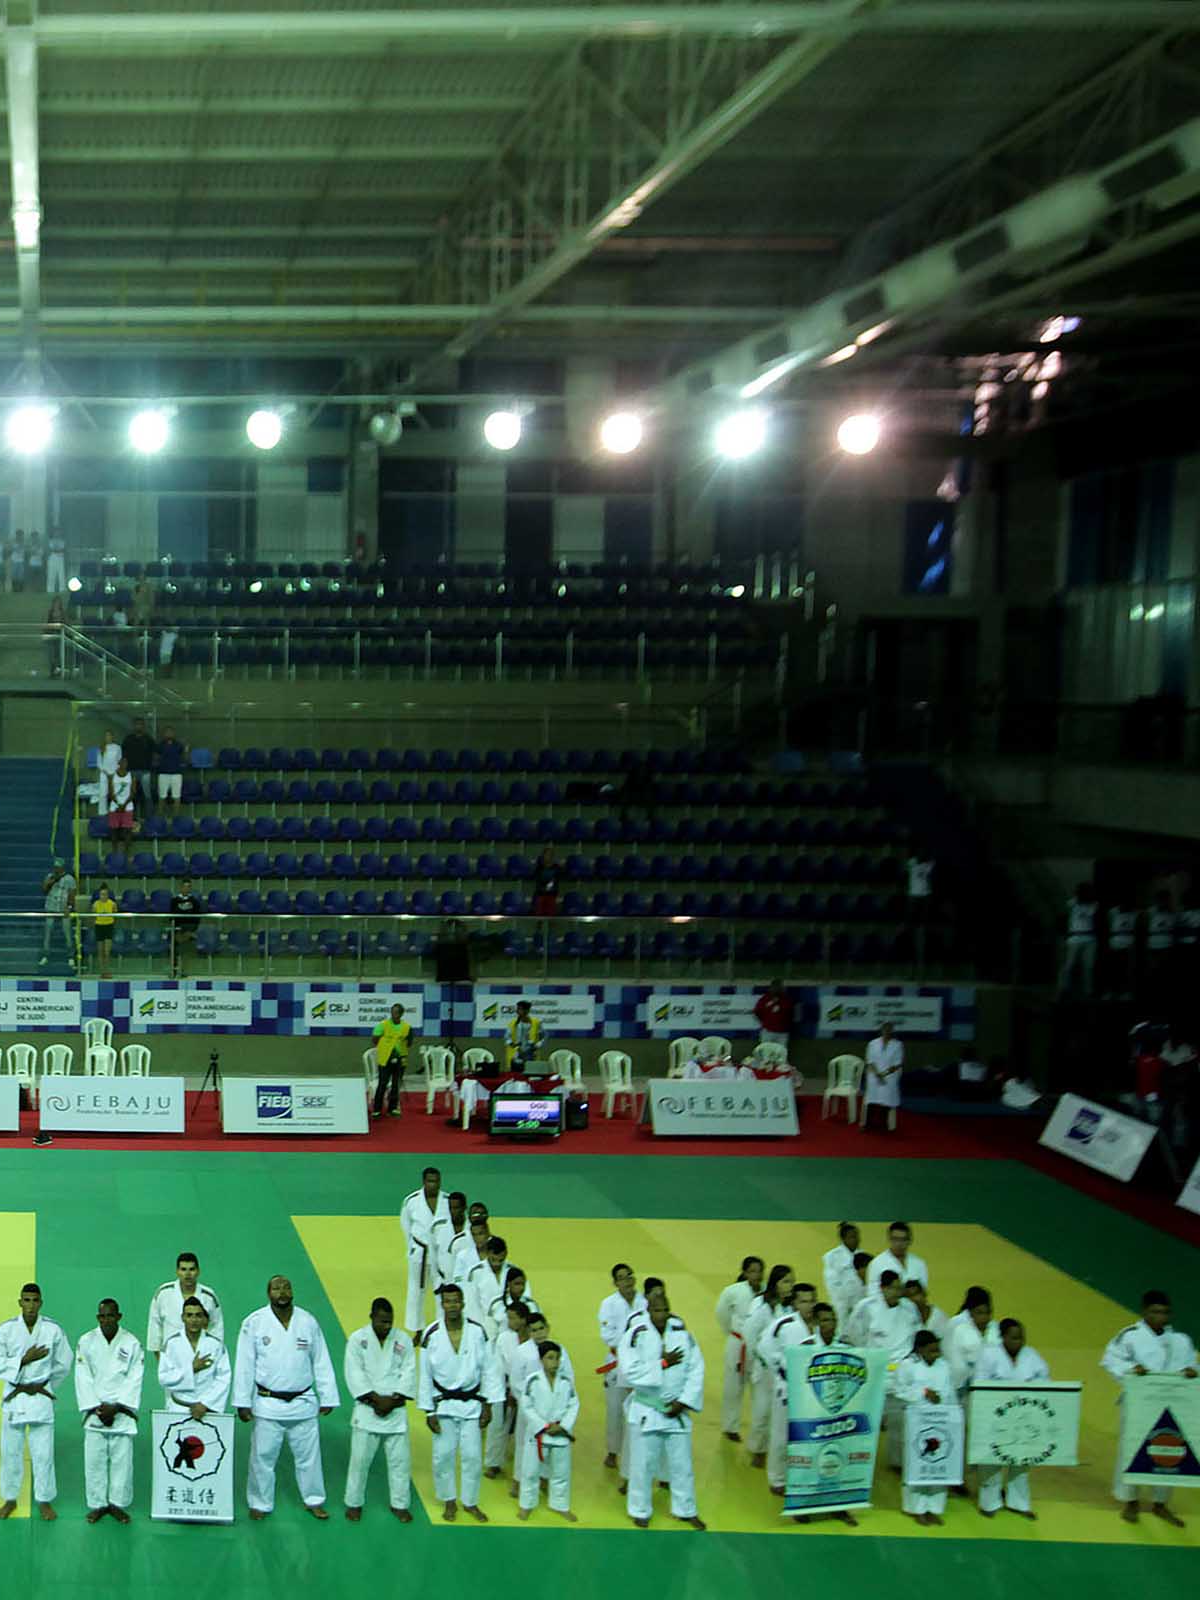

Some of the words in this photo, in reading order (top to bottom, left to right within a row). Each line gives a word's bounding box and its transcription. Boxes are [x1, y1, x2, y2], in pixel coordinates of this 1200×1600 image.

[157, 1000, 178, 1010] CBJ
[77, 1095, 171, 1109] FEBAJU
[258, 1095, 292, 1108] FIEB
[303, 1096, 328, 1107] SESI
[688, 1096, 789, 1112] FEBAJU
